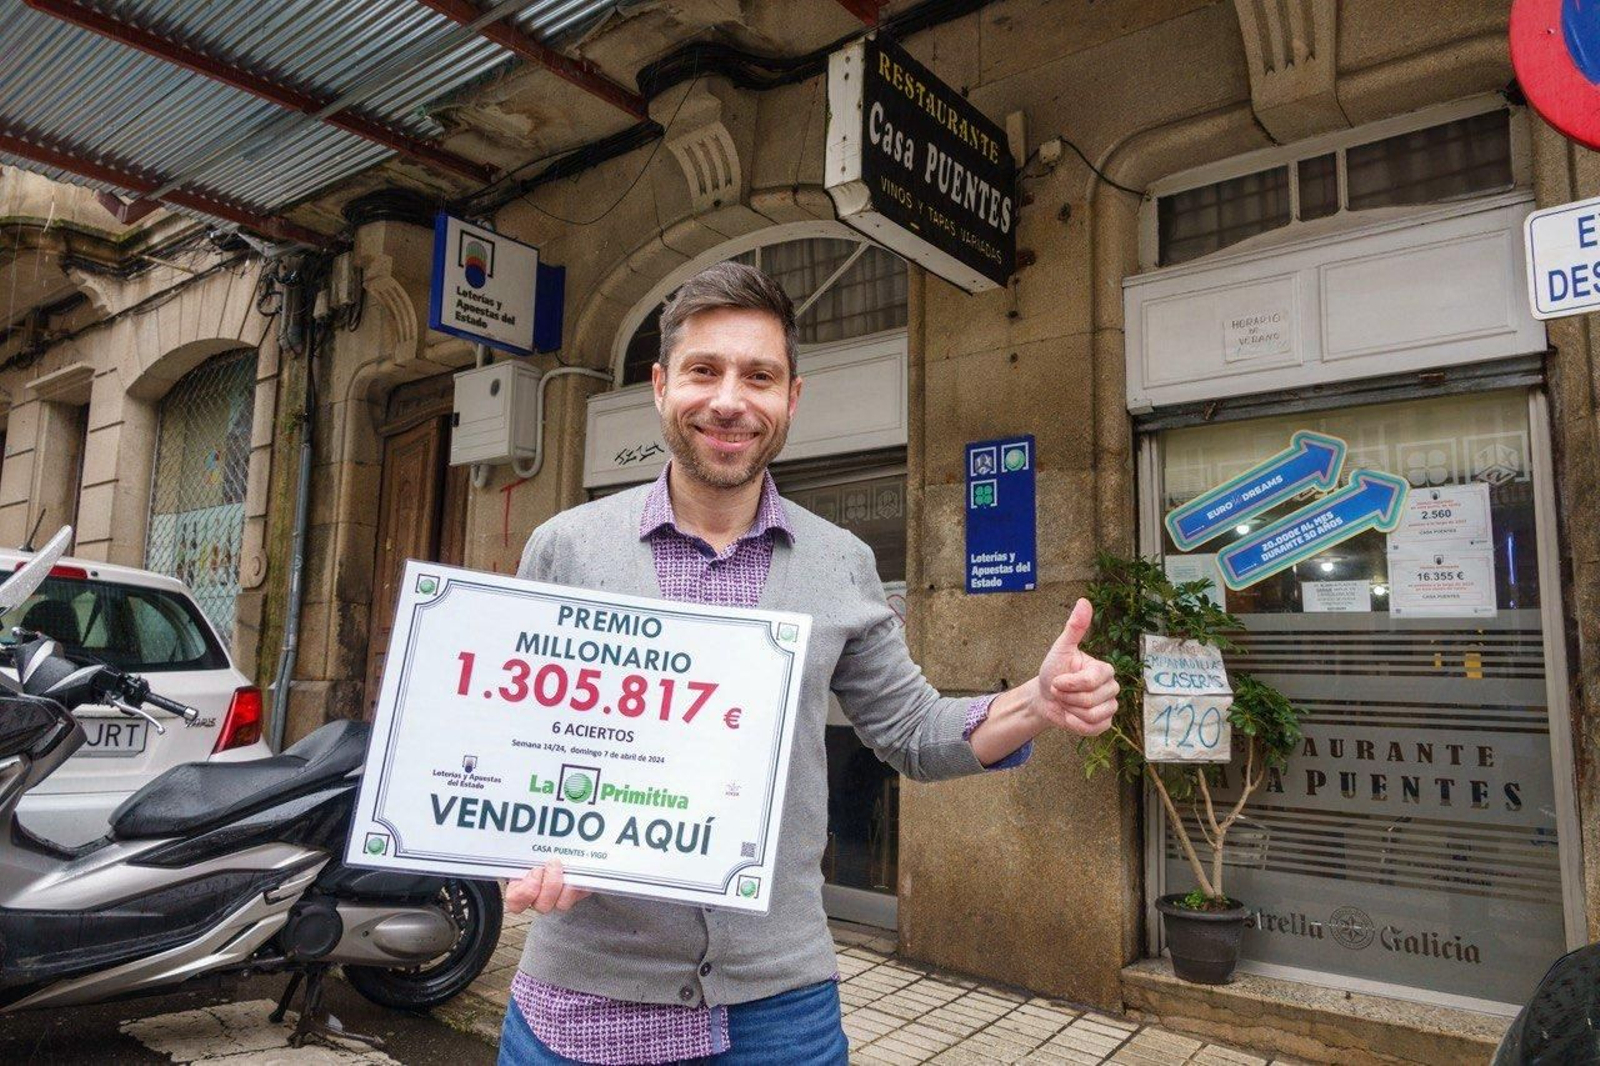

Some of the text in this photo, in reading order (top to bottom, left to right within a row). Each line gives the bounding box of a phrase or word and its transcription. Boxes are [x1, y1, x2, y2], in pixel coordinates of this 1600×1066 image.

[878, 51, 999, 164] RESTAURANTE
[870, 101, 1012, 234] Casa PUENTES
[881, 175, 912, 209] VINOS
[918, 202, 925, 216] Y
[928, 206, 956, 237] TAPAS
[456, 285, 503, 311] Loterías y
[455, 310, 488, 329] Estado
[456, 299, 516, 326] Apuestas del
[1206, 475, 1283, 520] EURO DREAMS
[1300, 522, 1315, 533] AL
[1313, 511, 1334, 526] MES
[1421, 509, 1452, 519] 2.560
[1260, 517, 1343, 562] DURANTE 30 AÑOS
[970, 551, 1016, 563] Loterías y
[971, 561, 1031, 577] Apuestas del
[970, 576, 1003, 588] Estado
[1417, 571, 1465, 581] 16.355 €
[557, 605, 662, 639] PREMIO
[515, 631, 692, 674] MILLONARIO
[456, 651, 742, 730] 1.305.817 €
[551, 721, 634, 743] 6 ACIERTOS
[511, 739, 542, 750] Semana
[570, 746, 602, 758] domingo
[603, 750, 609, 758] 7
[610, 751, 619, 759] de
[620, 752, 636, 761] abril
[638, 754, 646, 762] de
[648, 755, 665, 764] 2024
[460, 781, 484, 789] Estado
[469, 774, 501, 783] Apuestas
[1305, 769, 1522, 811] PUENTES
[529, 774, 689, 810] La Primitiva
[430, 793, 717, 856] VENDIDO AQUÍ
[531, 844, 552, 853] CASA
[553, 847, 585, 857] PUENTES
[590, 851, 607, 859] VIGO
[1244, 908, 1323, 941] strella
[1380, 926, 1482, 964] Galicia
